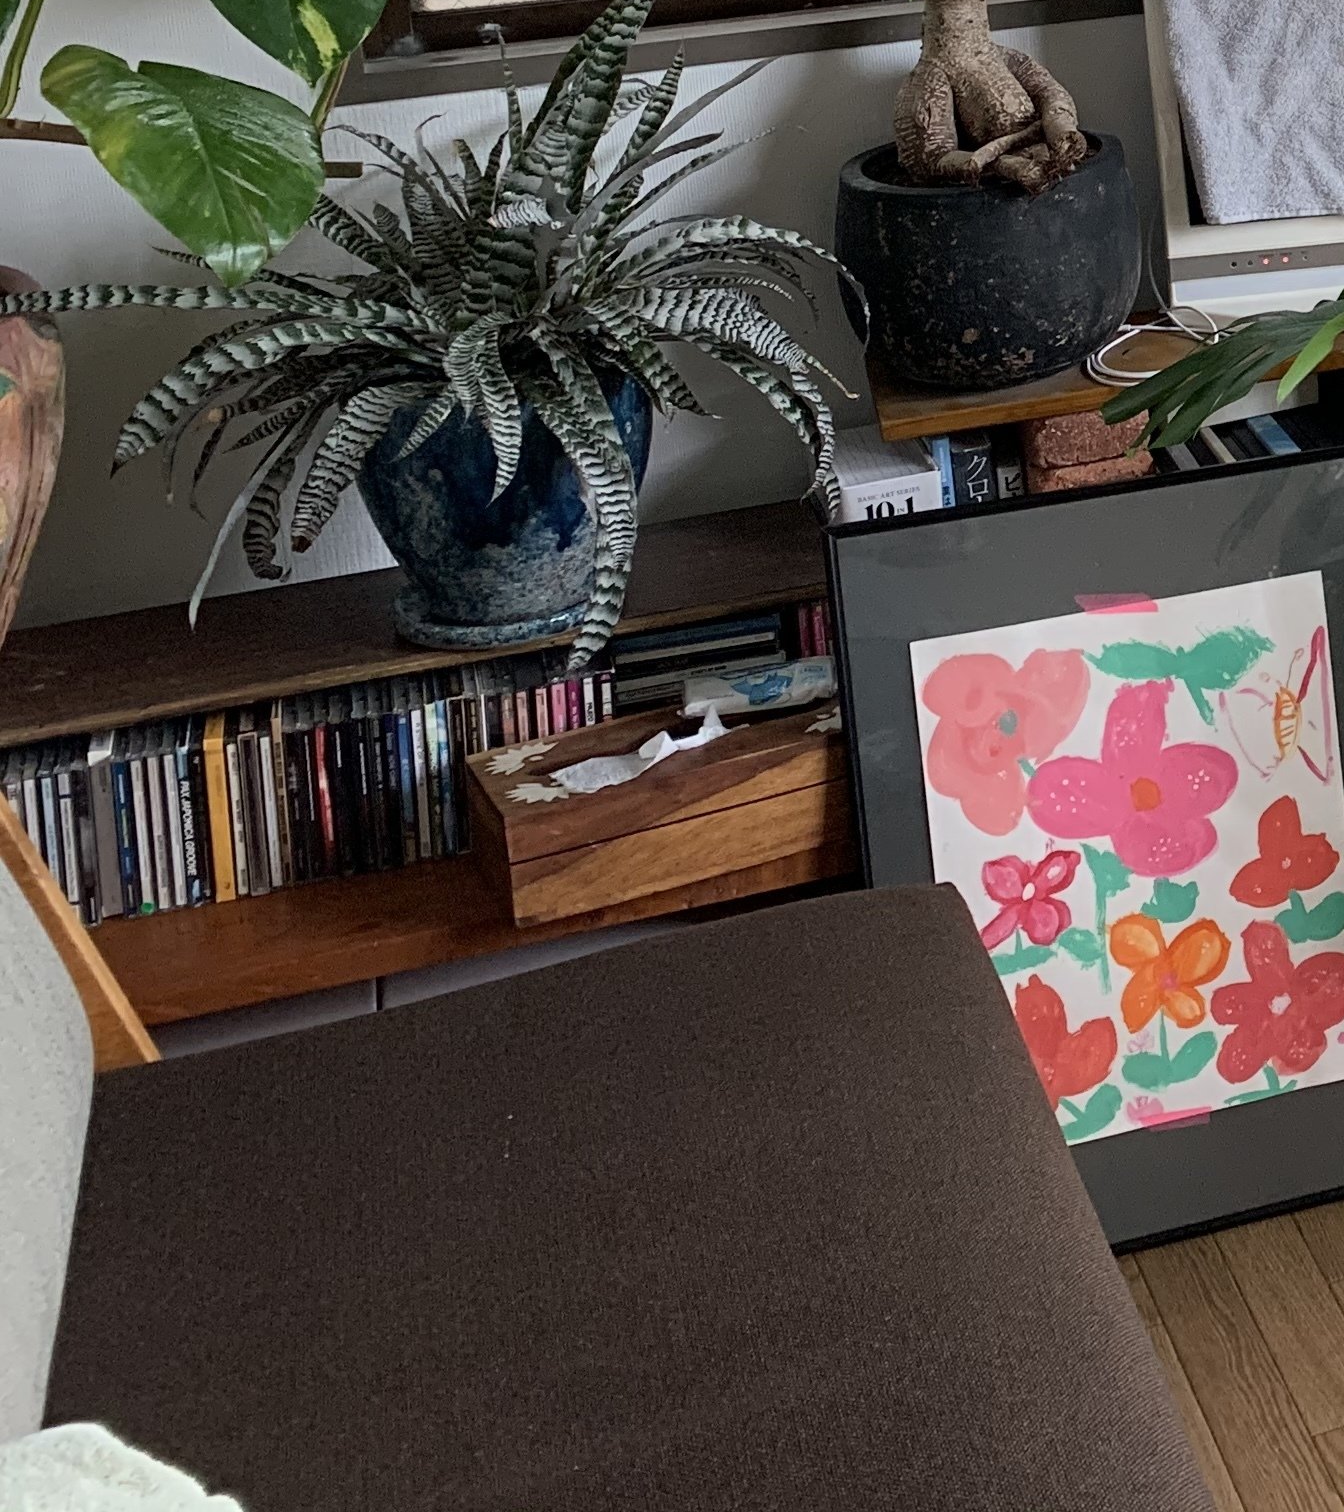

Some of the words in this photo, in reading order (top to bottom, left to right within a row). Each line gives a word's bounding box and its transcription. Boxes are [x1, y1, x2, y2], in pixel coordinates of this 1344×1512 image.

[966, 455, 989, 503] クロ
[857, 494, 879, 503] BASIC
[880, 490, 895, 499] ART
[896, 486, 921, 495] SERIES
[865, 500, 895, 521] 10
[904, 496, 914, 514] 1
[180, 780, 190, 797] PAX
[182, 798, 194, 841] JAPONICA
[184, 841, 197, 876] GROOVE
